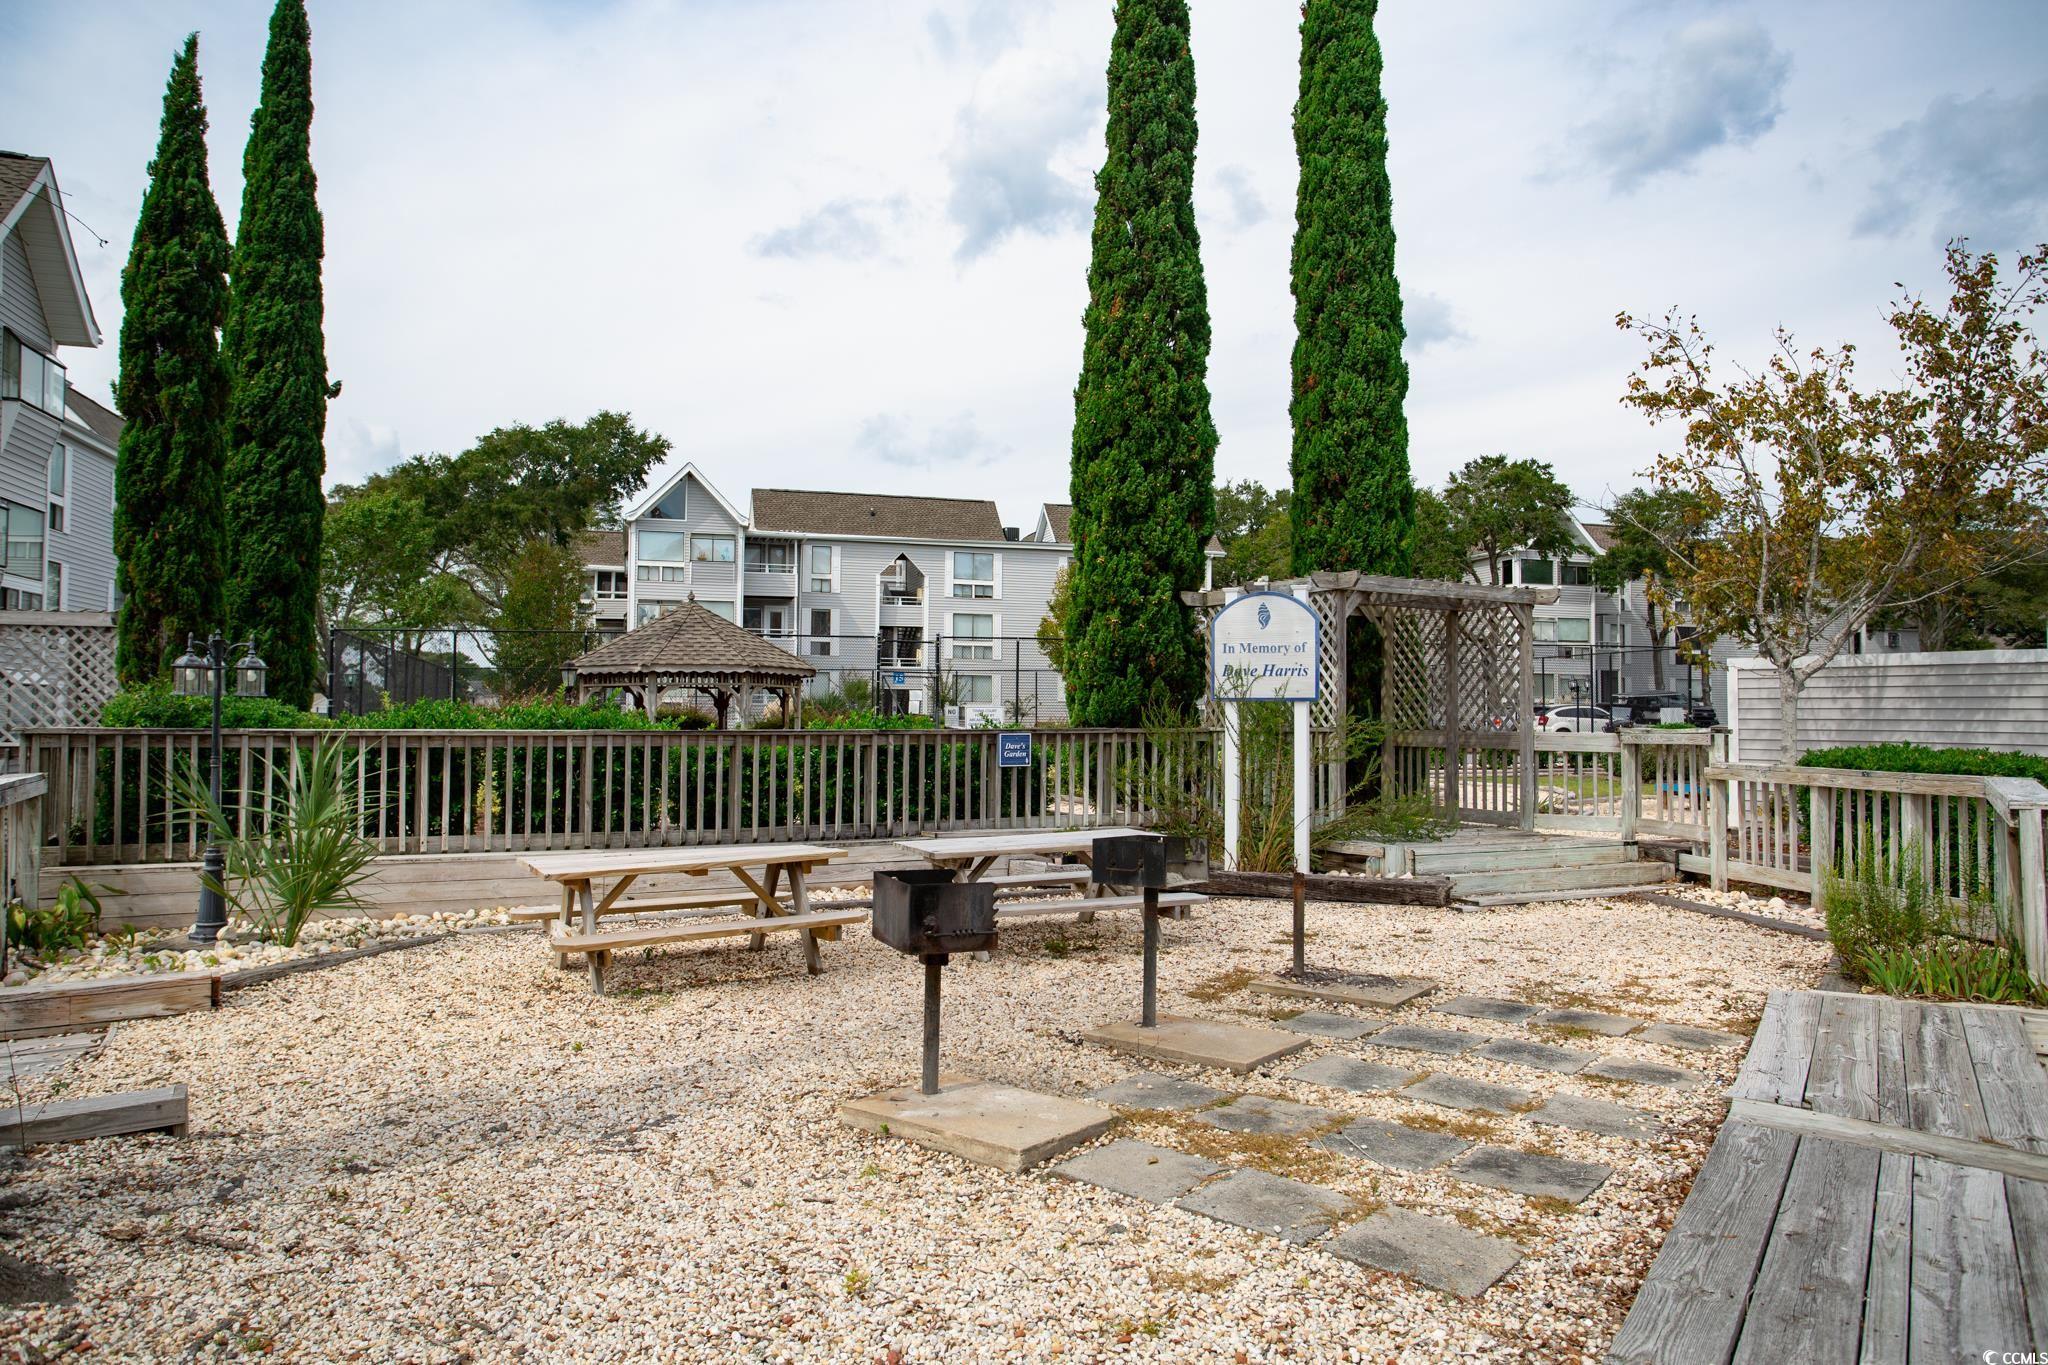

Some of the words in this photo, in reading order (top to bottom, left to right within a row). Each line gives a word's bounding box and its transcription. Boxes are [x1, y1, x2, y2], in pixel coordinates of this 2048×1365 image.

[1222, 643, 1235, 654] In
[1239, 642, 1290, 656] Memory
[1294, 641, 1307, 653] of
[1222, 664, 1258, 677] Dave
[1262, 663, 1309, 677] Harris
[1004, 750, 1026, 758] Garden
